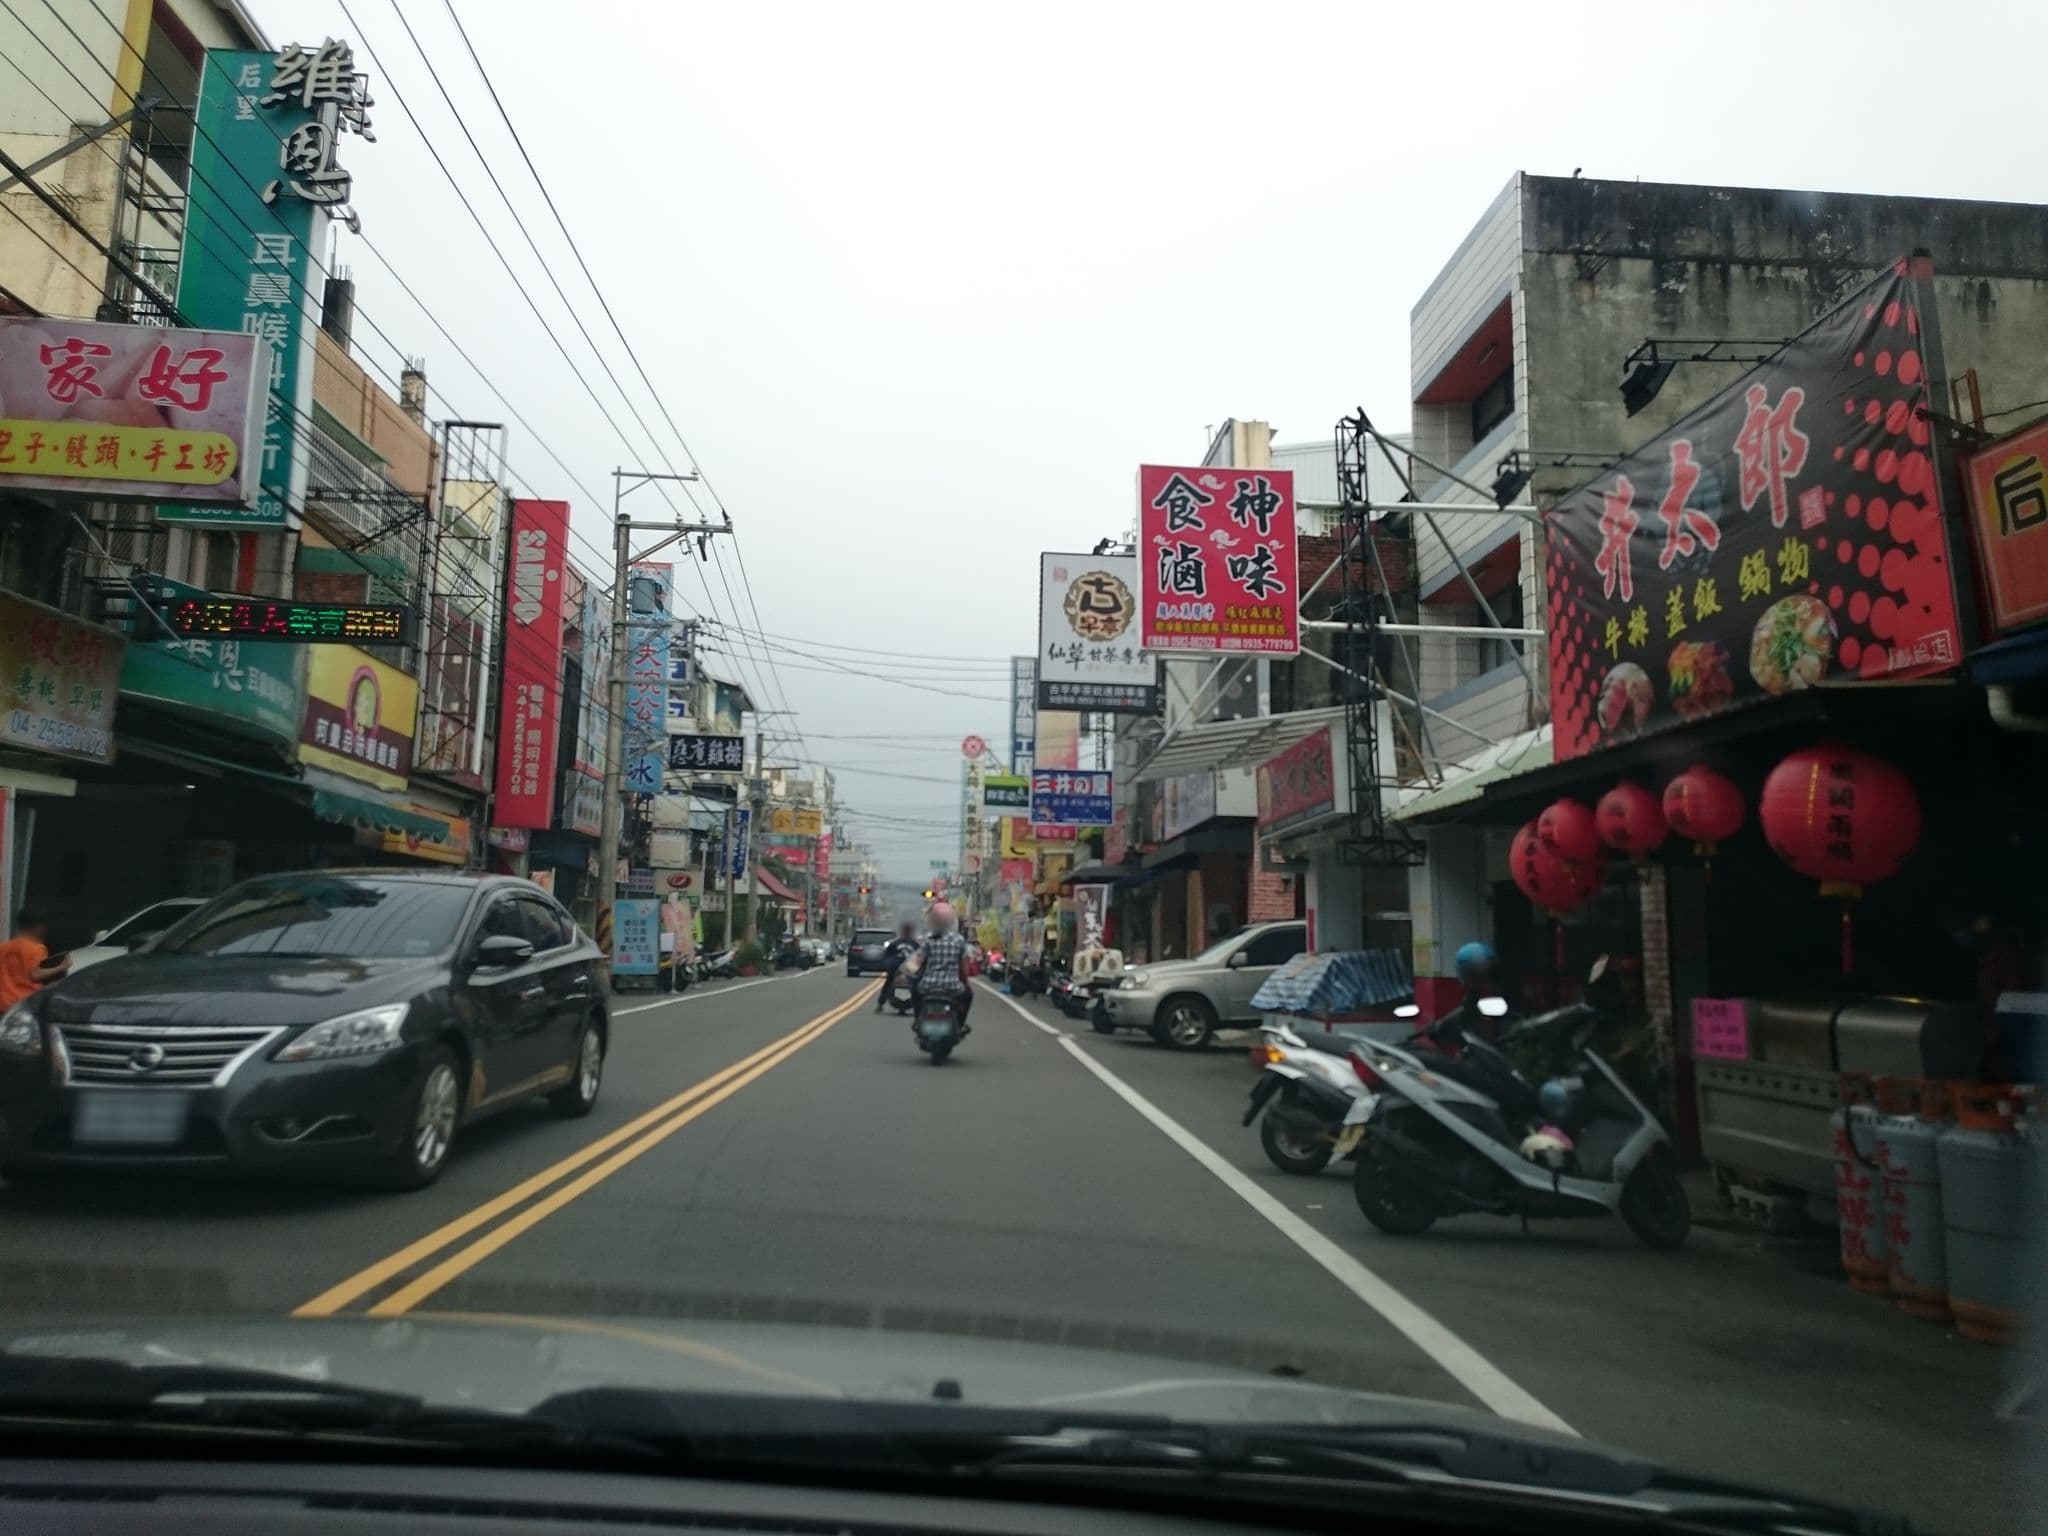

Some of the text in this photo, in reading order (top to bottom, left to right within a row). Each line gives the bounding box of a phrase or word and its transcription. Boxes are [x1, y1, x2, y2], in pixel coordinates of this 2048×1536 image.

[235, 62, 261, 122] 后里
[258, 36, 358, 206] 維恩
[1154, 472, 1284, 534] 食神
[1994, 455, 2048, 536] 后
[1158, 544, 1287, 600] 滷味
[1604, 536, 1810, 660] 牛排 蓋飯 鍋物
